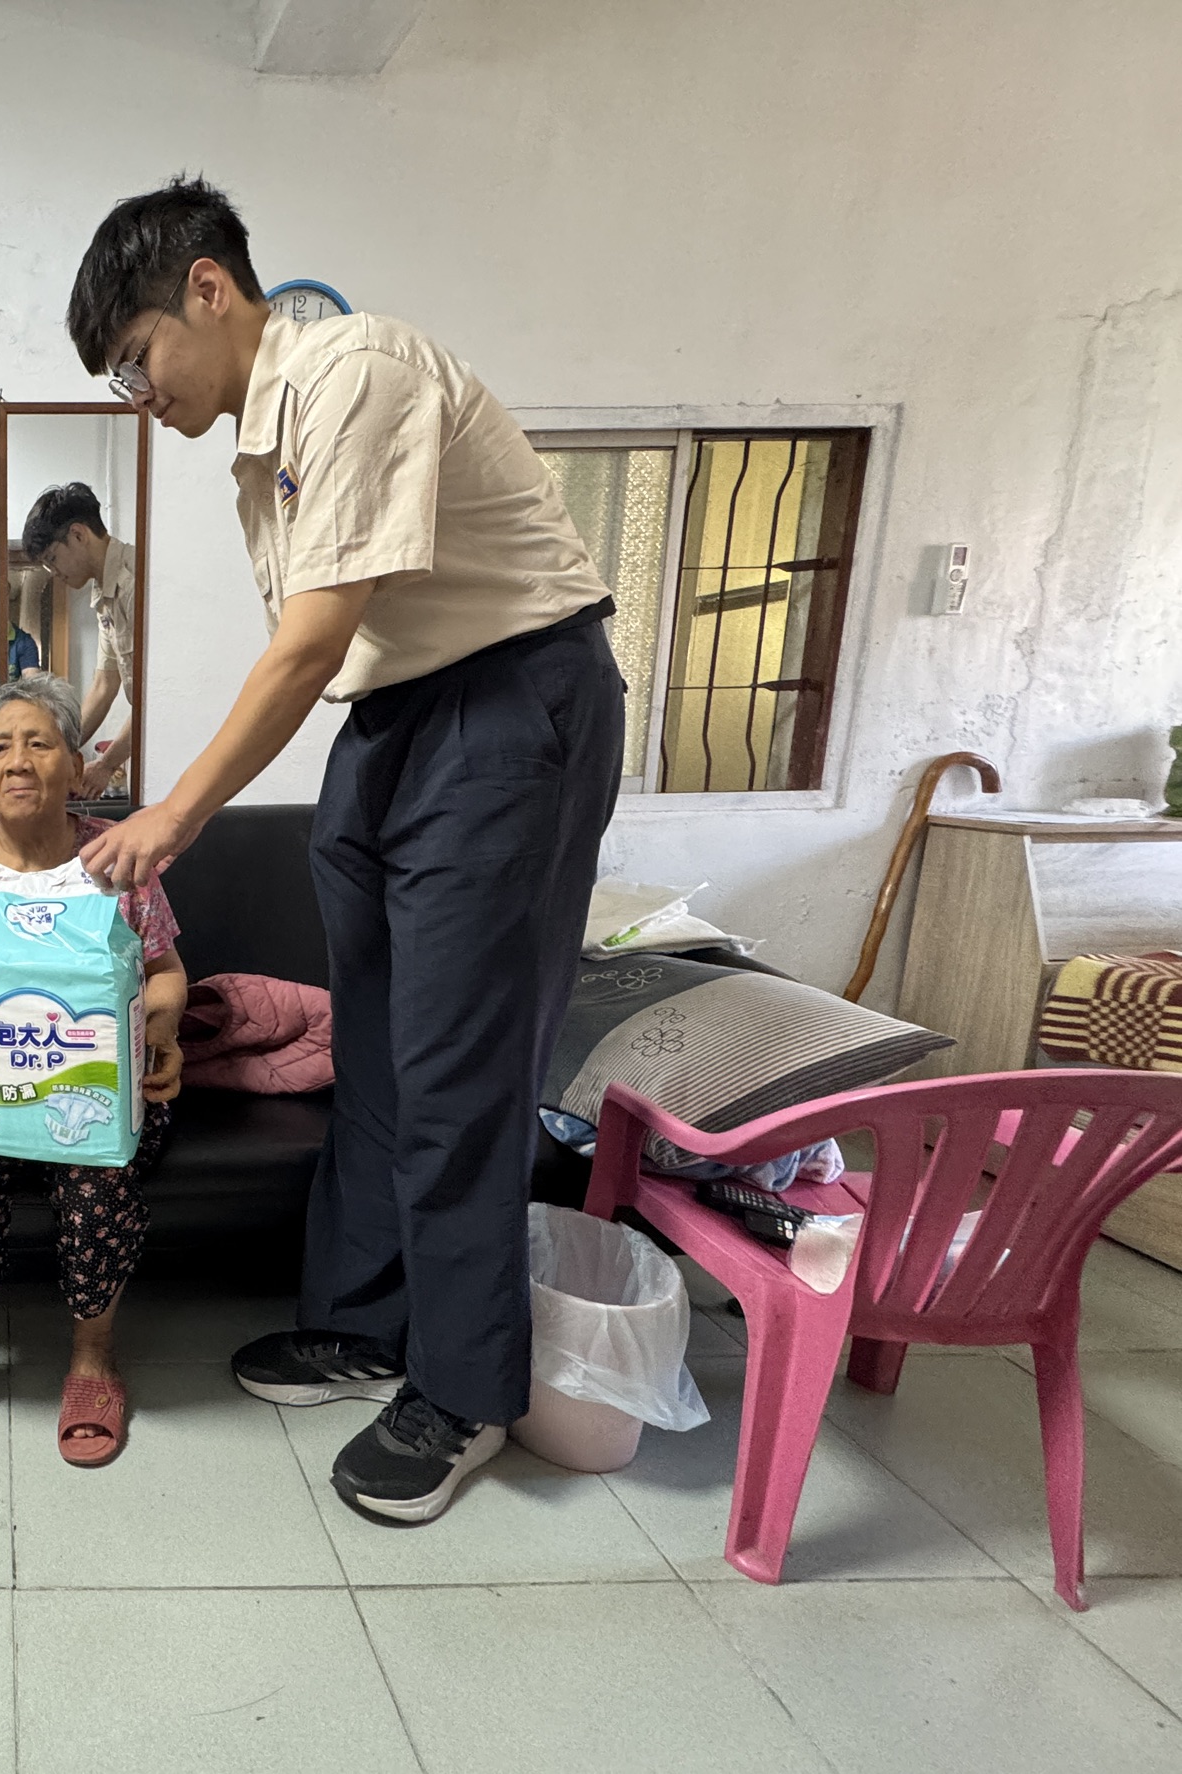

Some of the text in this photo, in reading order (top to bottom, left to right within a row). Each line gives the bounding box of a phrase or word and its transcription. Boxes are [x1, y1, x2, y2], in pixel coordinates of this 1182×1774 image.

[292, 295, 307, 314] 12
[10, 1049, 65, 1069] Dr. P
